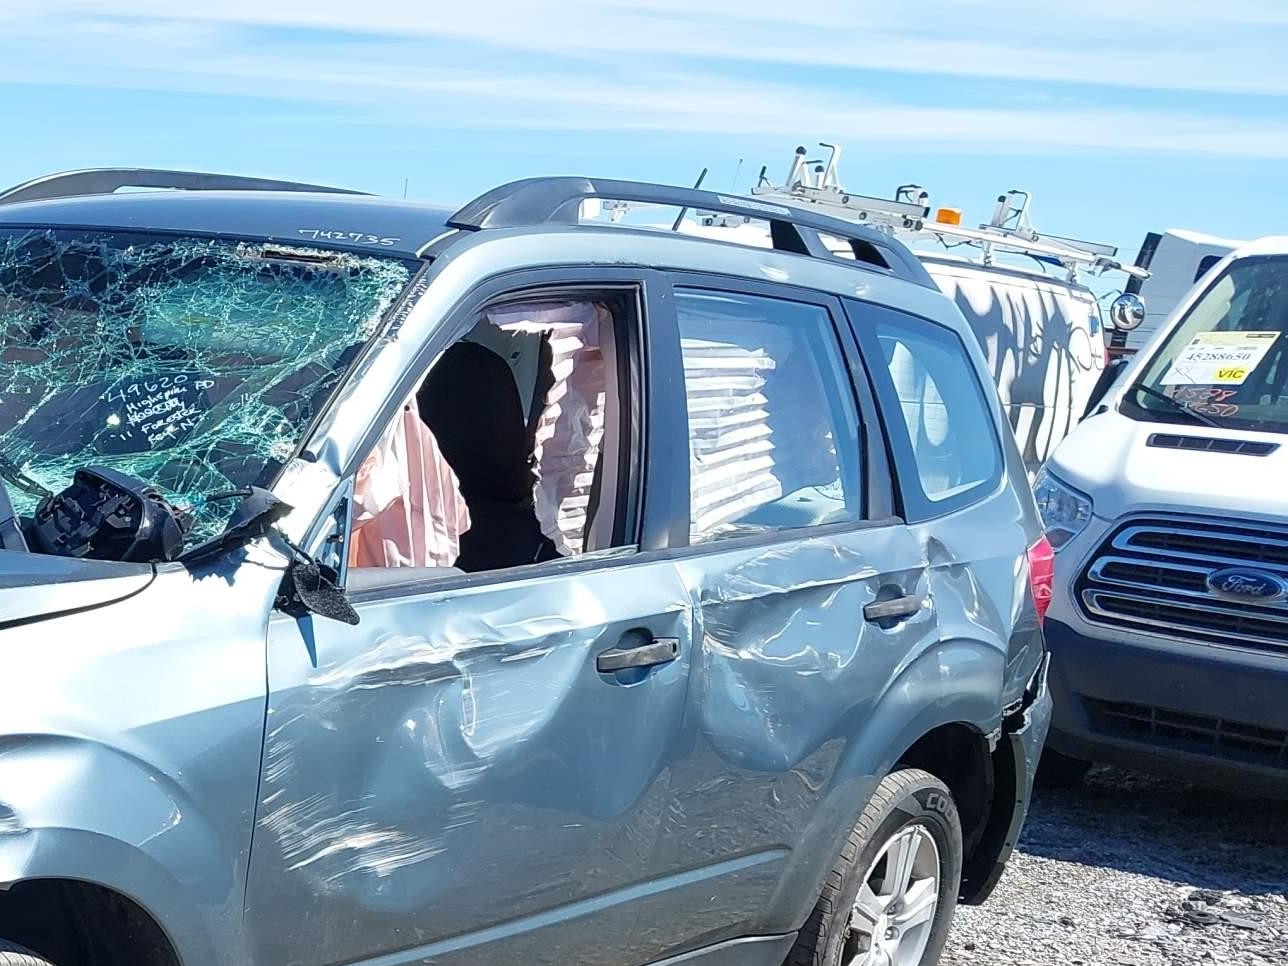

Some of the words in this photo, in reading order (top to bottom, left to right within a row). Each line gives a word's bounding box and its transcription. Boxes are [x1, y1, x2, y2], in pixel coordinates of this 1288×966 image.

[298, 229, 401, 246] 742735
[1186, 351, 1252, 361] 45288650
[1222, 574, 1265, 595] Ford
